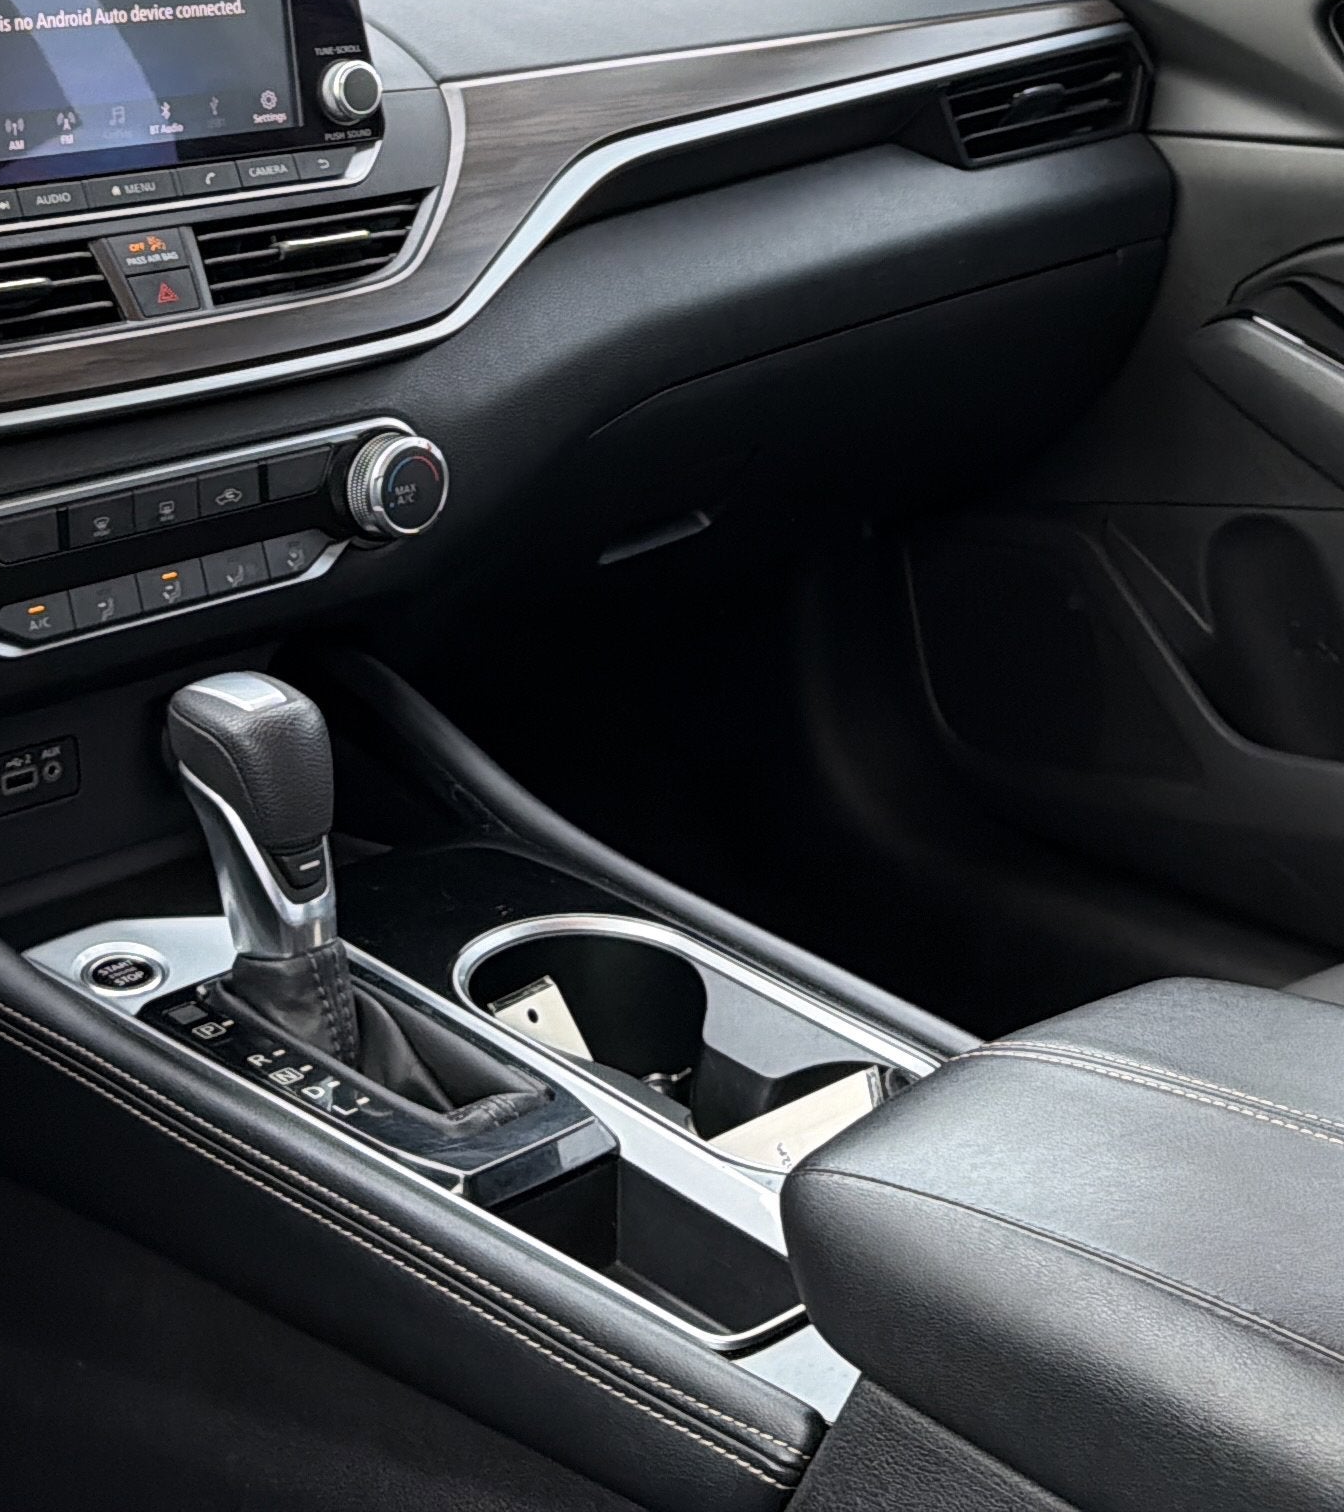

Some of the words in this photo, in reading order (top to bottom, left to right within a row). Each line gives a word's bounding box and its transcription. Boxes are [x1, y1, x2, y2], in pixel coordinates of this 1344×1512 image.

[14, 15, 34, 31] no
[36, 8, 92, 28] Android
[94, 6, 128, 25] Auto
[130, 2, 174, 22] device
[253, 110, 287, 125] Settings
[149, 124, 163, 135] BT
[163, 121, 184, 134] Audio
[324, 131, 345, 142] PUSH
[347, 128, 372, 140] SOUND
[8, 138, 26, 151] AM
[59, 134, 74, 145] FM
[248, 163, 288, 178] CAMERA
[125, 180, 157, 195] MENU
[36, 191, 71, 207] AUDIO
[395, 483, 417, 496] MAX
[397, 493, 415, 504] A/C
[28, 616, 52, 632] A/C
[98, 960, 134, 976] START
[114, 970, 145, 986] STOP
[247, 1053, 272, 1067] R
[300, 1086, 326, 1099] D
[331, 1104, 359, 1116] L
